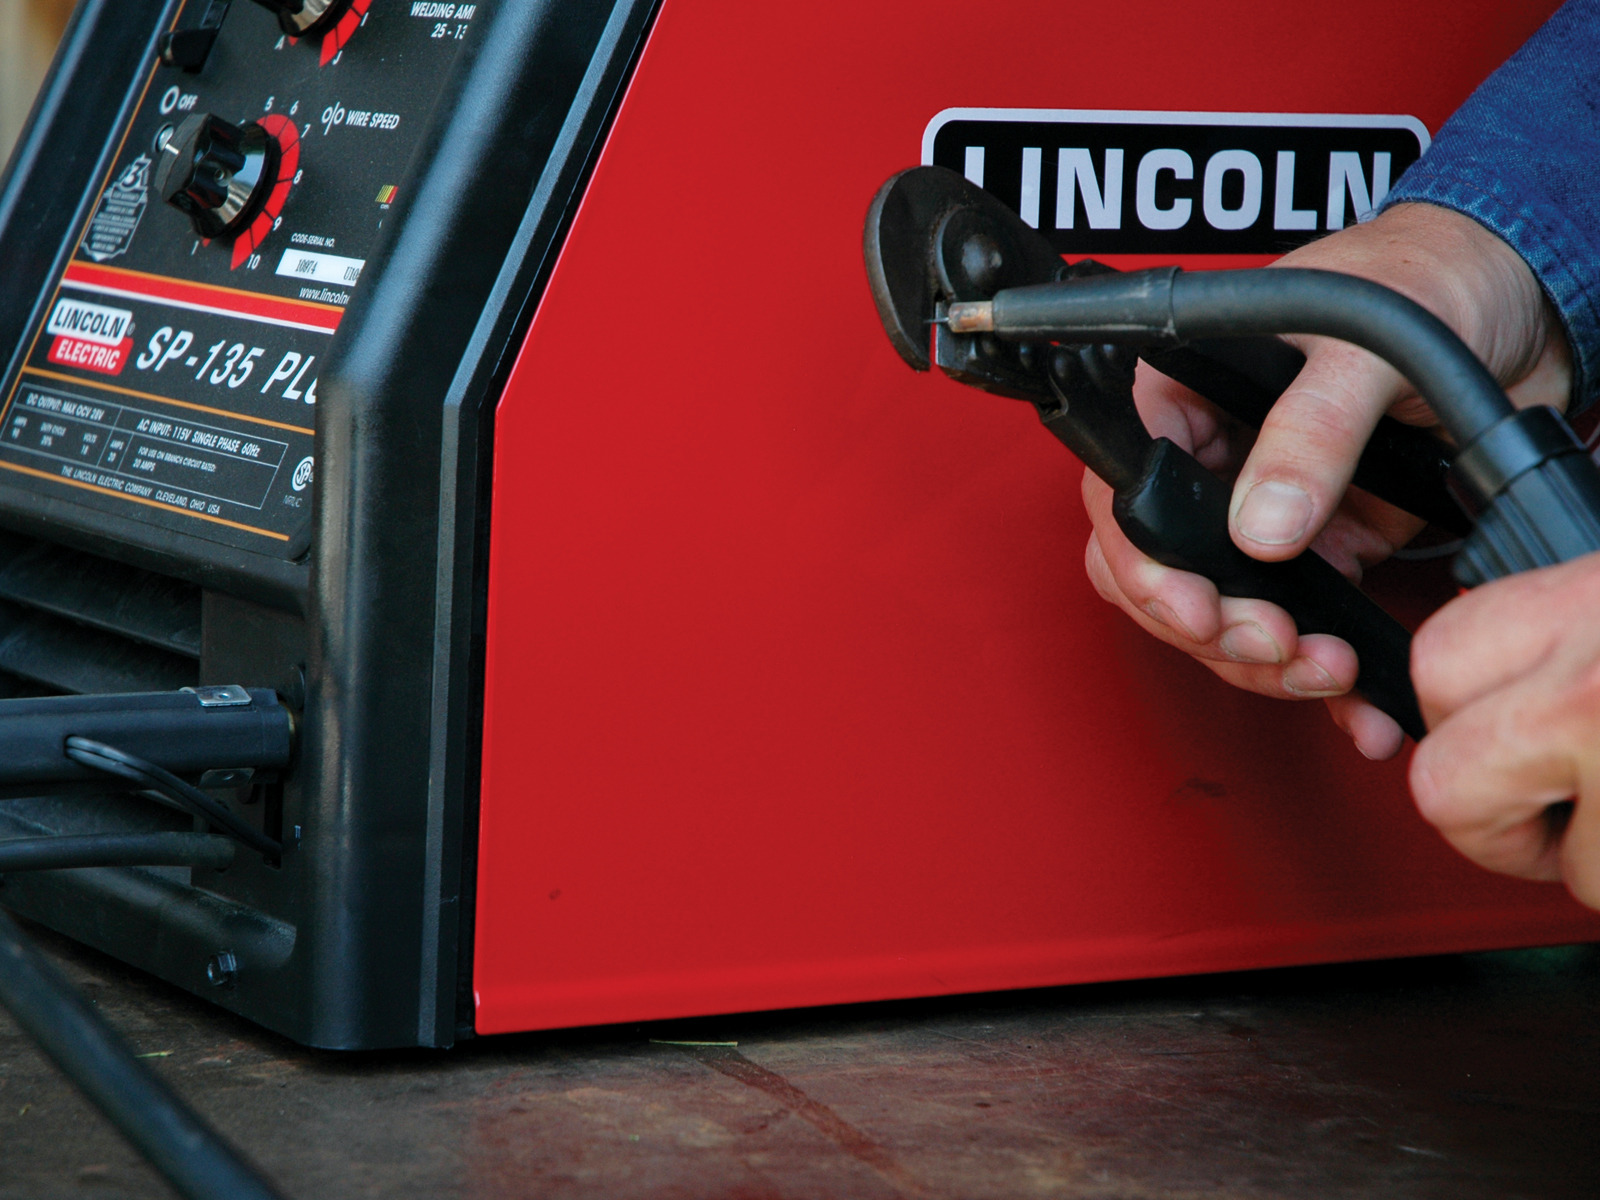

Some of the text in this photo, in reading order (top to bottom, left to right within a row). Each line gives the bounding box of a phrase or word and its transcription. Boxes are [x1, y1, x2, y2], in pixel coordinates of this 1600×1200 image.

[410, 1, 476, 19] WELDING AM
[431, 23, 447, 38] 25
[274, 35, 285, 50] A
[332, 50, 343, 65] J
[177, 93, 198, 110] OFF
[264, 96, 275, 112] 5
[290, 100, 299, 115] 6
[345, 110, 400, 129] WIRE SPEED
[301, 123, 311, 138] 7
[293, 169, 303, 185] 8
[273, 216, 283, 231] 9
[190, 240, 199, 256] 1
[246, 253, 261, 270] 10
[54, 305, 126, 339] LINCOLN
[55, 339, 121, 370] ELECTRIC
[136, 326, 265, 389] SP-135
[26, 392, 39, 406] DC
[61, 401, 78, 415] MAX
[137, 418, 261, 458] AC INPUT: 115V SINGLE PHASE 60Hz
[132, 458, 157, 472] 20 AMPS
[137, 446, 150, 456] FOR
[148, 449, 158, 459] USE
[156, 451, 166, 460] ON
[164, 452, 185, 465] BRANCH
[182, 456, 203, 469] CIRCUIT
[61, 465, 221, 515] THE LINCOLN ELECTRIC COMPANY CLEVELAND, OHIO USA
